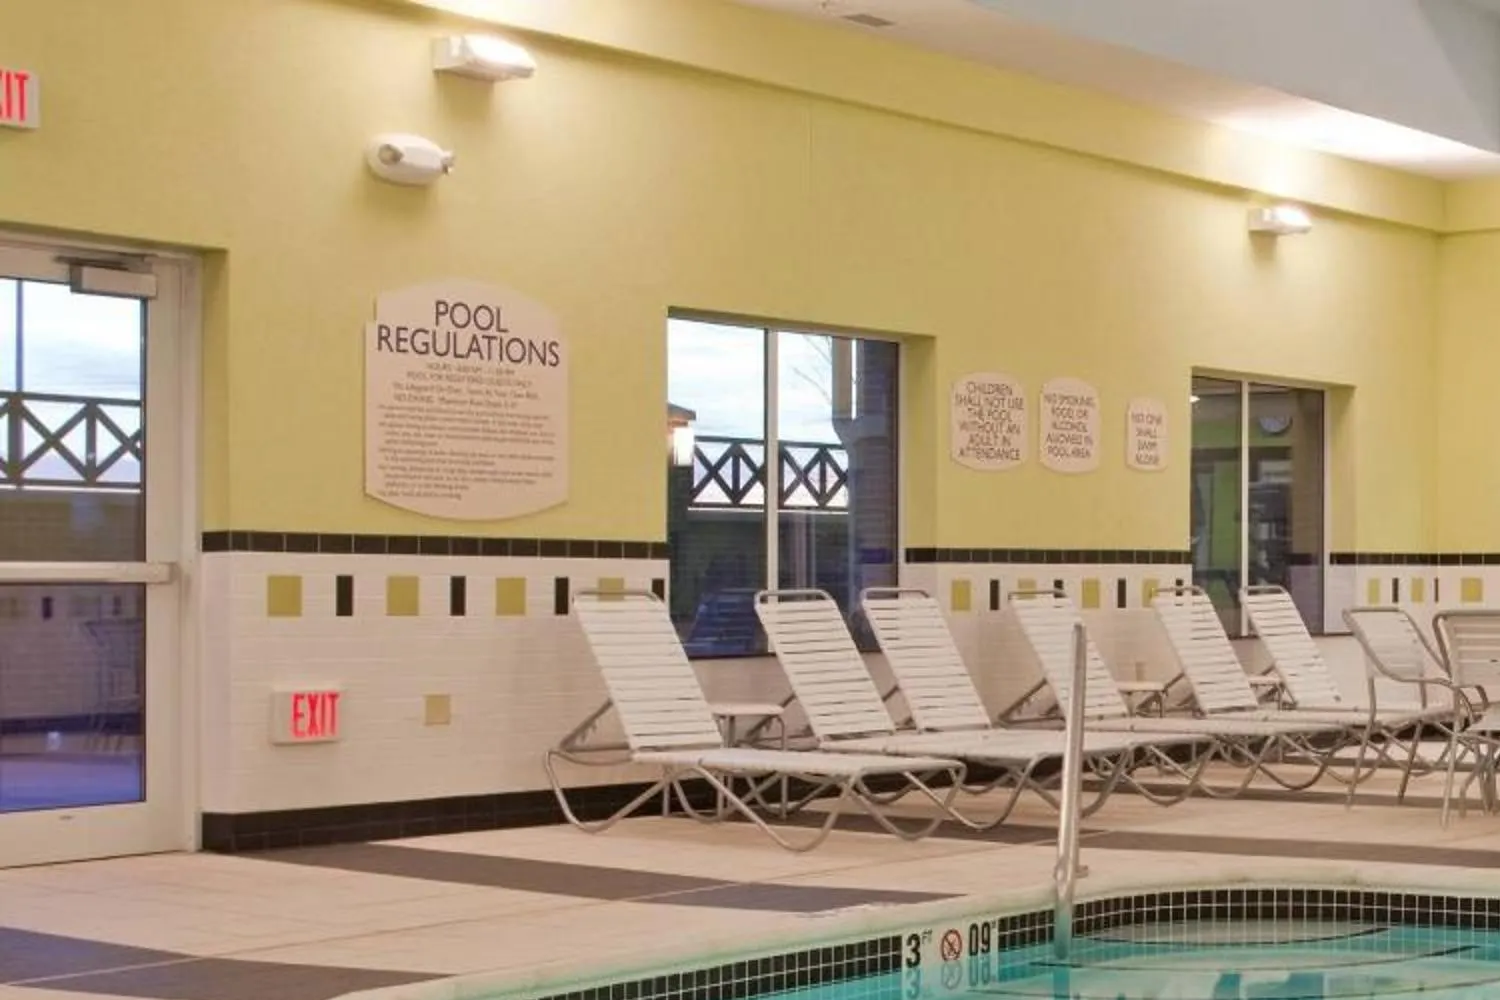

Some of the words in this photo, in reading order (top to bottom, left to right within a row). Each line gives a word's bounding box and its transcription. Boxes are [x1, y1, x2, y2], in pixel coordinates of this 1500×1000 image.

[435, 300, 509, 333] POOL
[377, 323, 560, 367] REGULATIONS
[967, 381, 1013, 396] CHILDREN
[293, 692, 339, 738] EXIT
